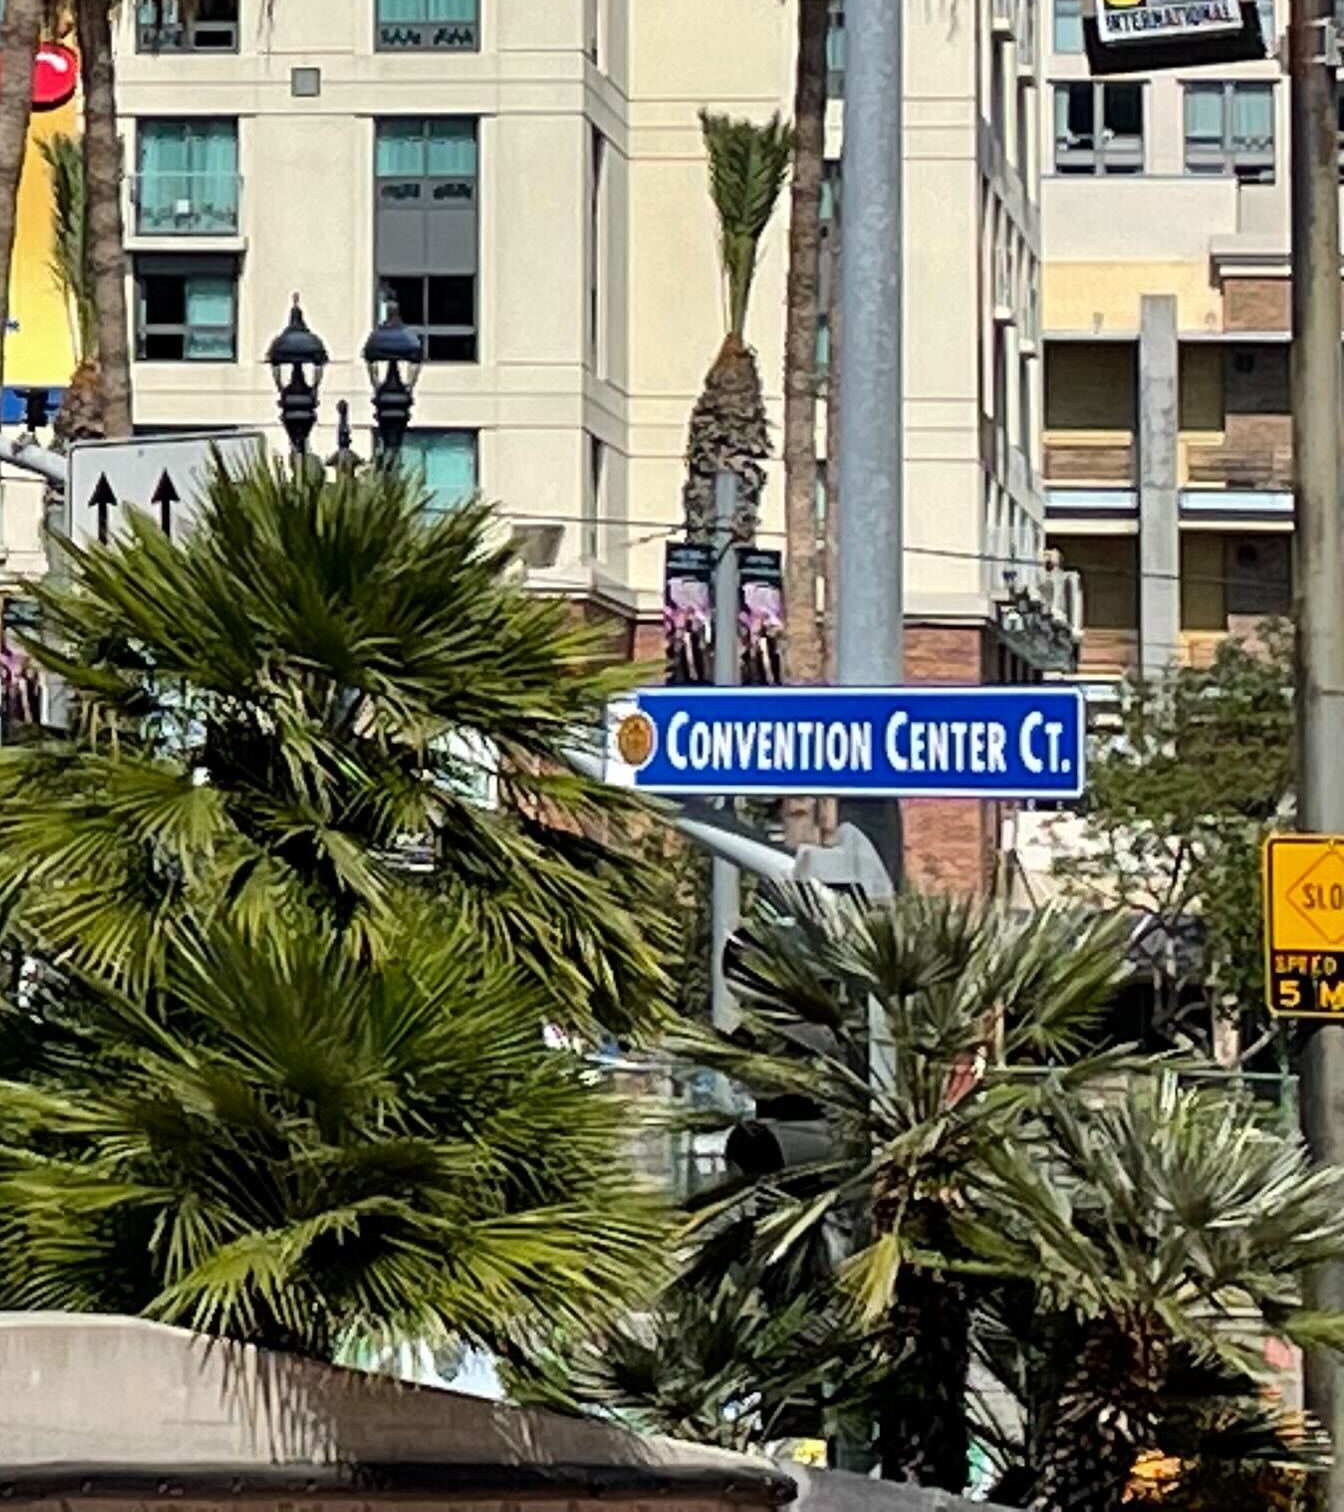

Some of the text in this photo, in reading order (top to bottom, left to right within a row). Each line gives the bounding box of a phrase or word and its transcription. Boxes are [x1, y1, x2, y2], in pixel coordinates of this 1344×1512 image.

[1105, 0, 1235, 33] INTERNATIONAL
[666, 710, 872, 772] CONVENTION
[885, 710, 1007, 773] CENTER
[1301, 882, 1344, 910] SLO
[1279, 979, 1344, 1011] 5 M
